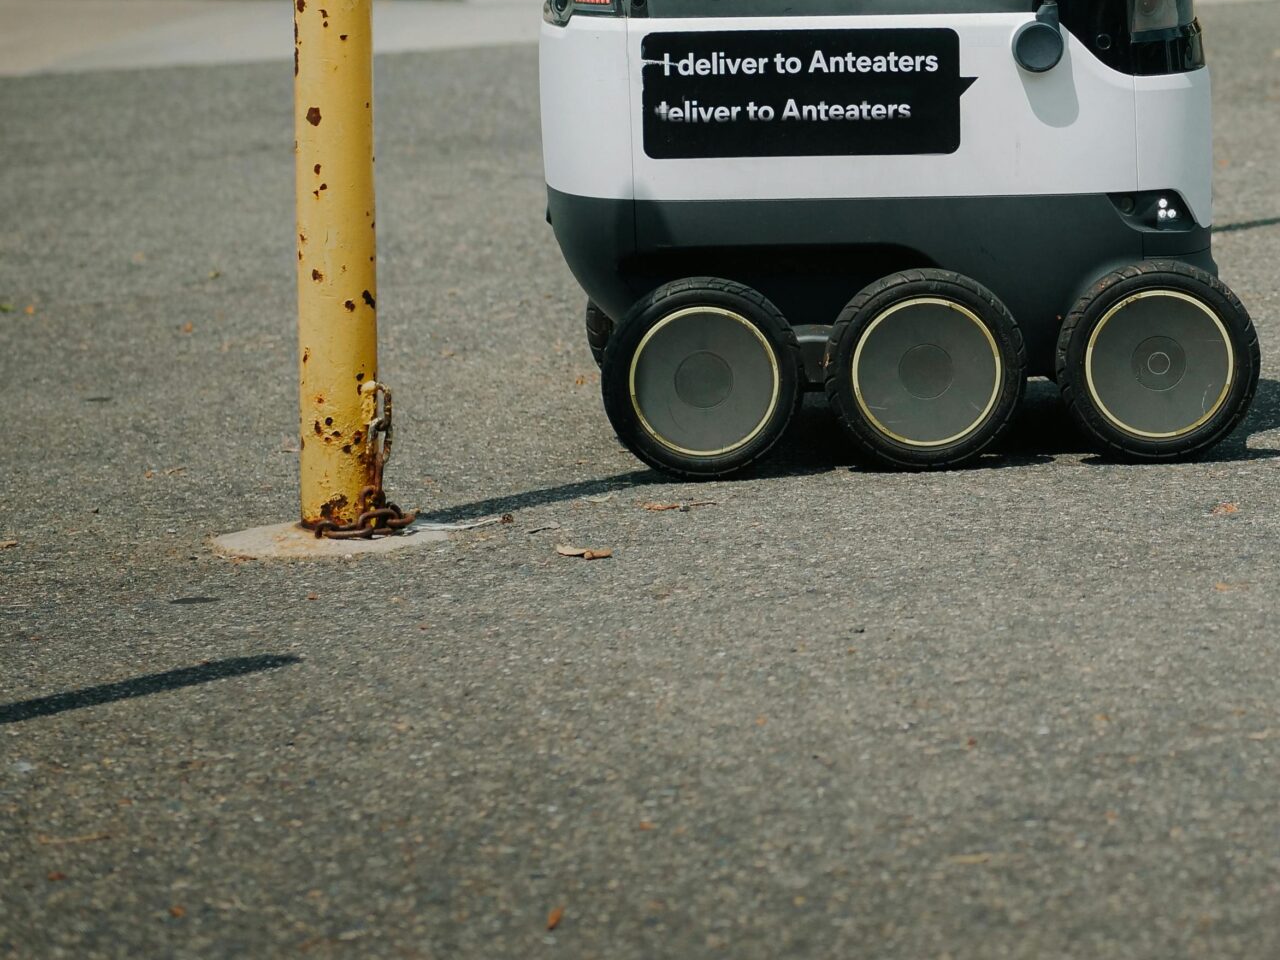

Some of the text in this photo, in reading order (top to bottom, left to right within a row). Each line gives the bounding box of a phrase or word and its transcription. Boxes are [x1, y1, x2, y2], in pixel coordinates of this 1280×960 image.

[663, 49, 939, 76] I deliver to Anteaters
[746, 101, 775, 123] to
[781, 98, 912, 122] Anteaters
